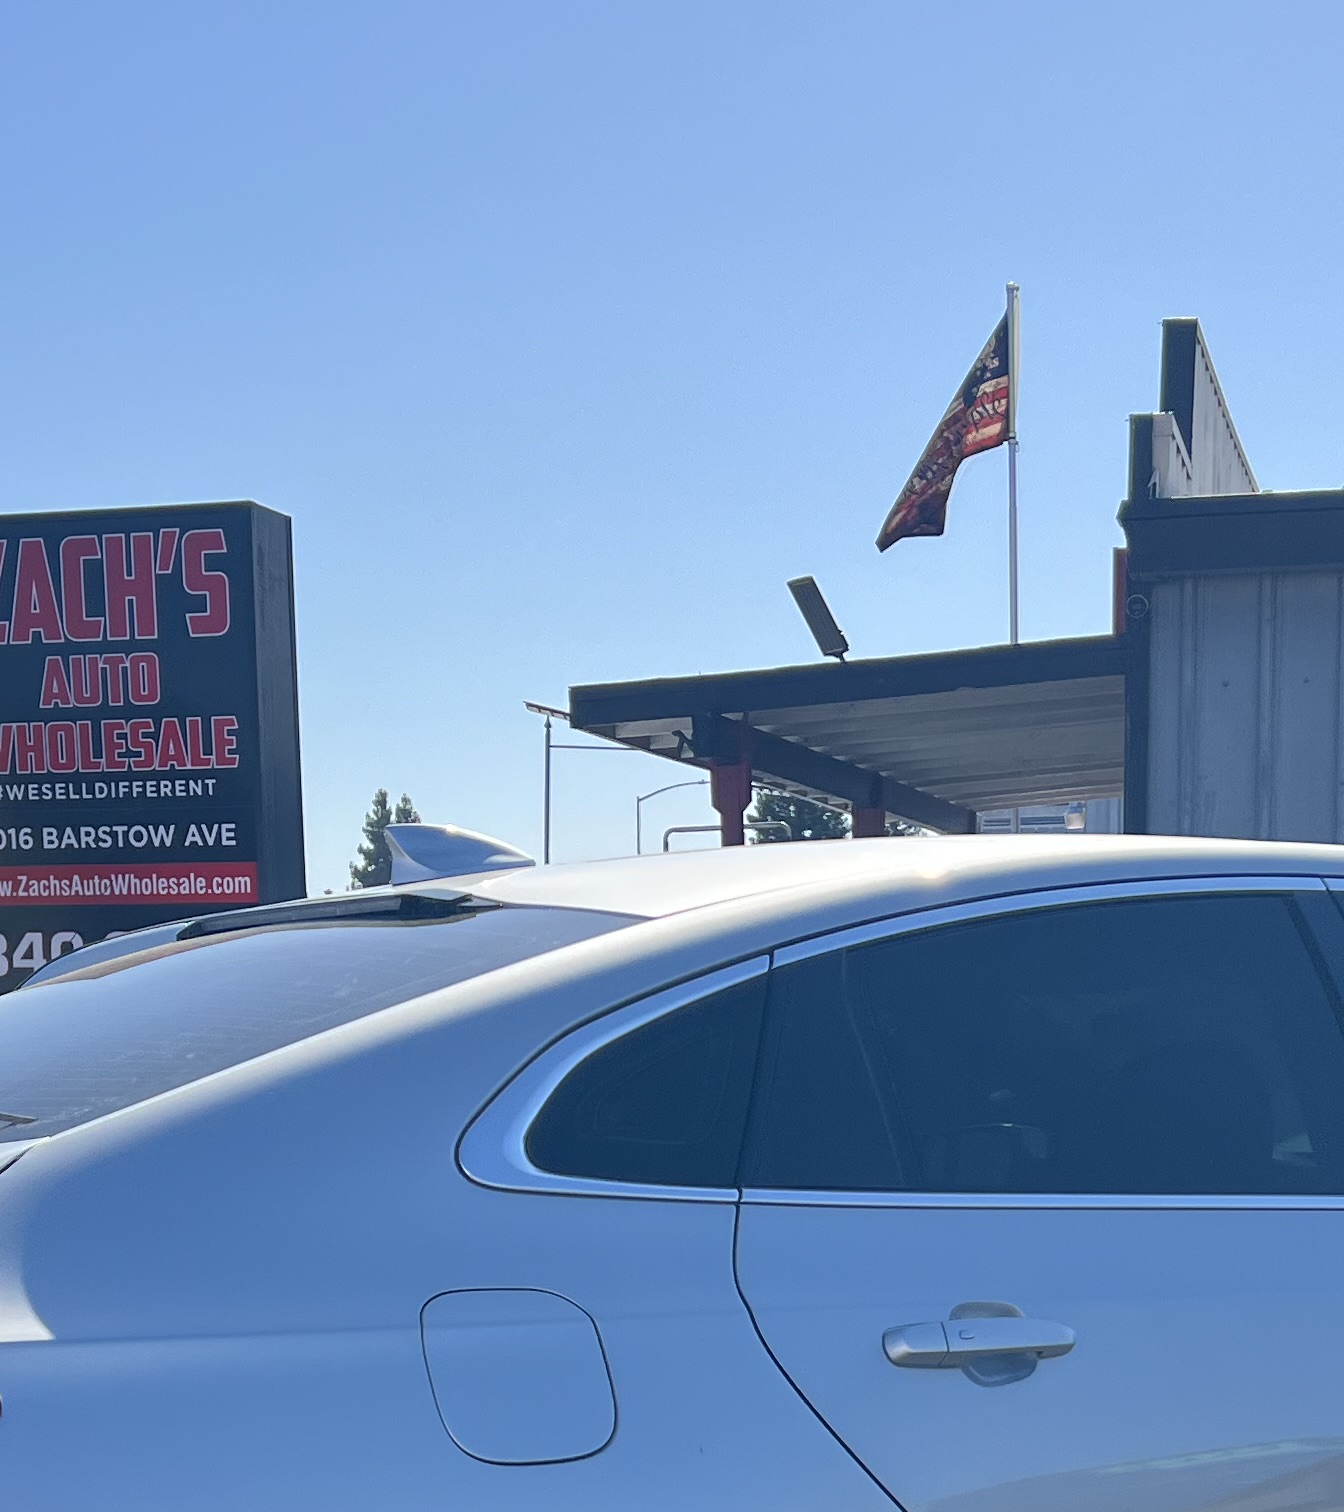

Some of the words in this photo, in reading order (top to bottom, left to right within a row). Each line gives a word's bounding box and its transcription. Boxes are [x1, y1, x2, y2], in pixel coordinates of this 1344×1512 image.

[40, 653, 160, 708] AUTO
[43, 825, 175, 849] BARSTOW
[185, 823, 237, 846] AVE
